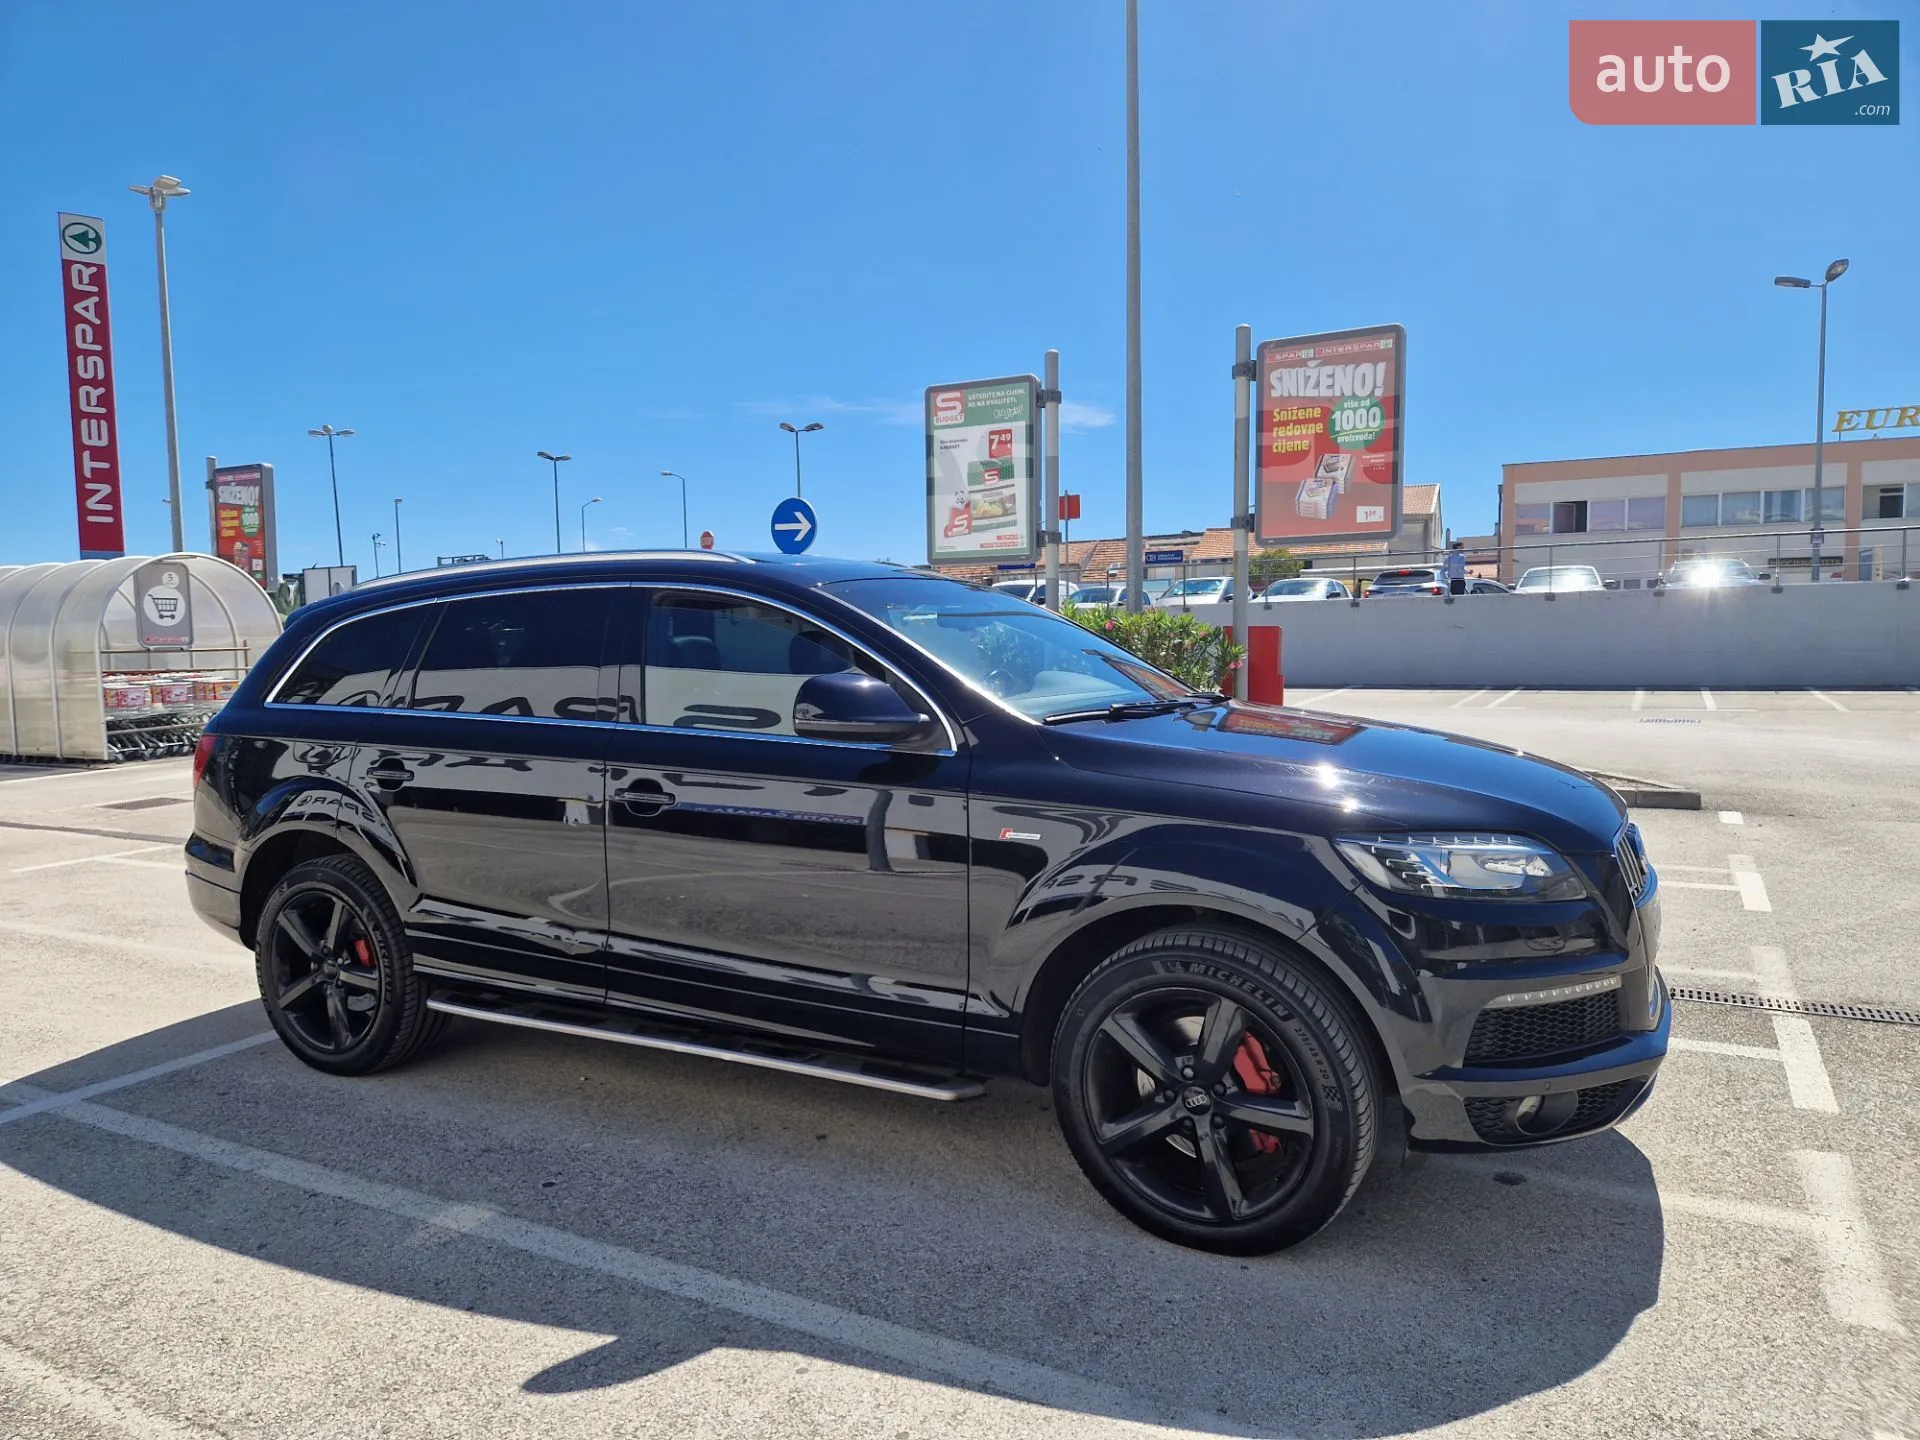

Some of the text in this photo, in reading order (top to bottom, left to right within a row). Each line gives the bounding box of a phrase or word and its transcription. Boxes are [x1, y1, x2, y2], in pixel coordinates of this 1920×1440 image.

[1275, 352, 1302, 361] SPAR
[1270, 359, 1387, 398] SNIŽENO!
[70, 263, 115, 524] INTERSPAR
[936, 391, 962, 416] S
[1343, 398, 1370, 409] više od
[935, 413, 964, 424] BUDGET
[1272, 406, 1321, 422] Snižene
[1331, 407, 1381, 432] 1000
[1832, 406, 1920, 433] EUR
[1272, 422, 1323, 437] redovne
[1272, 440, 1310, 454] cijene
[1189, 962, 1290, 1018] MICHELIN
